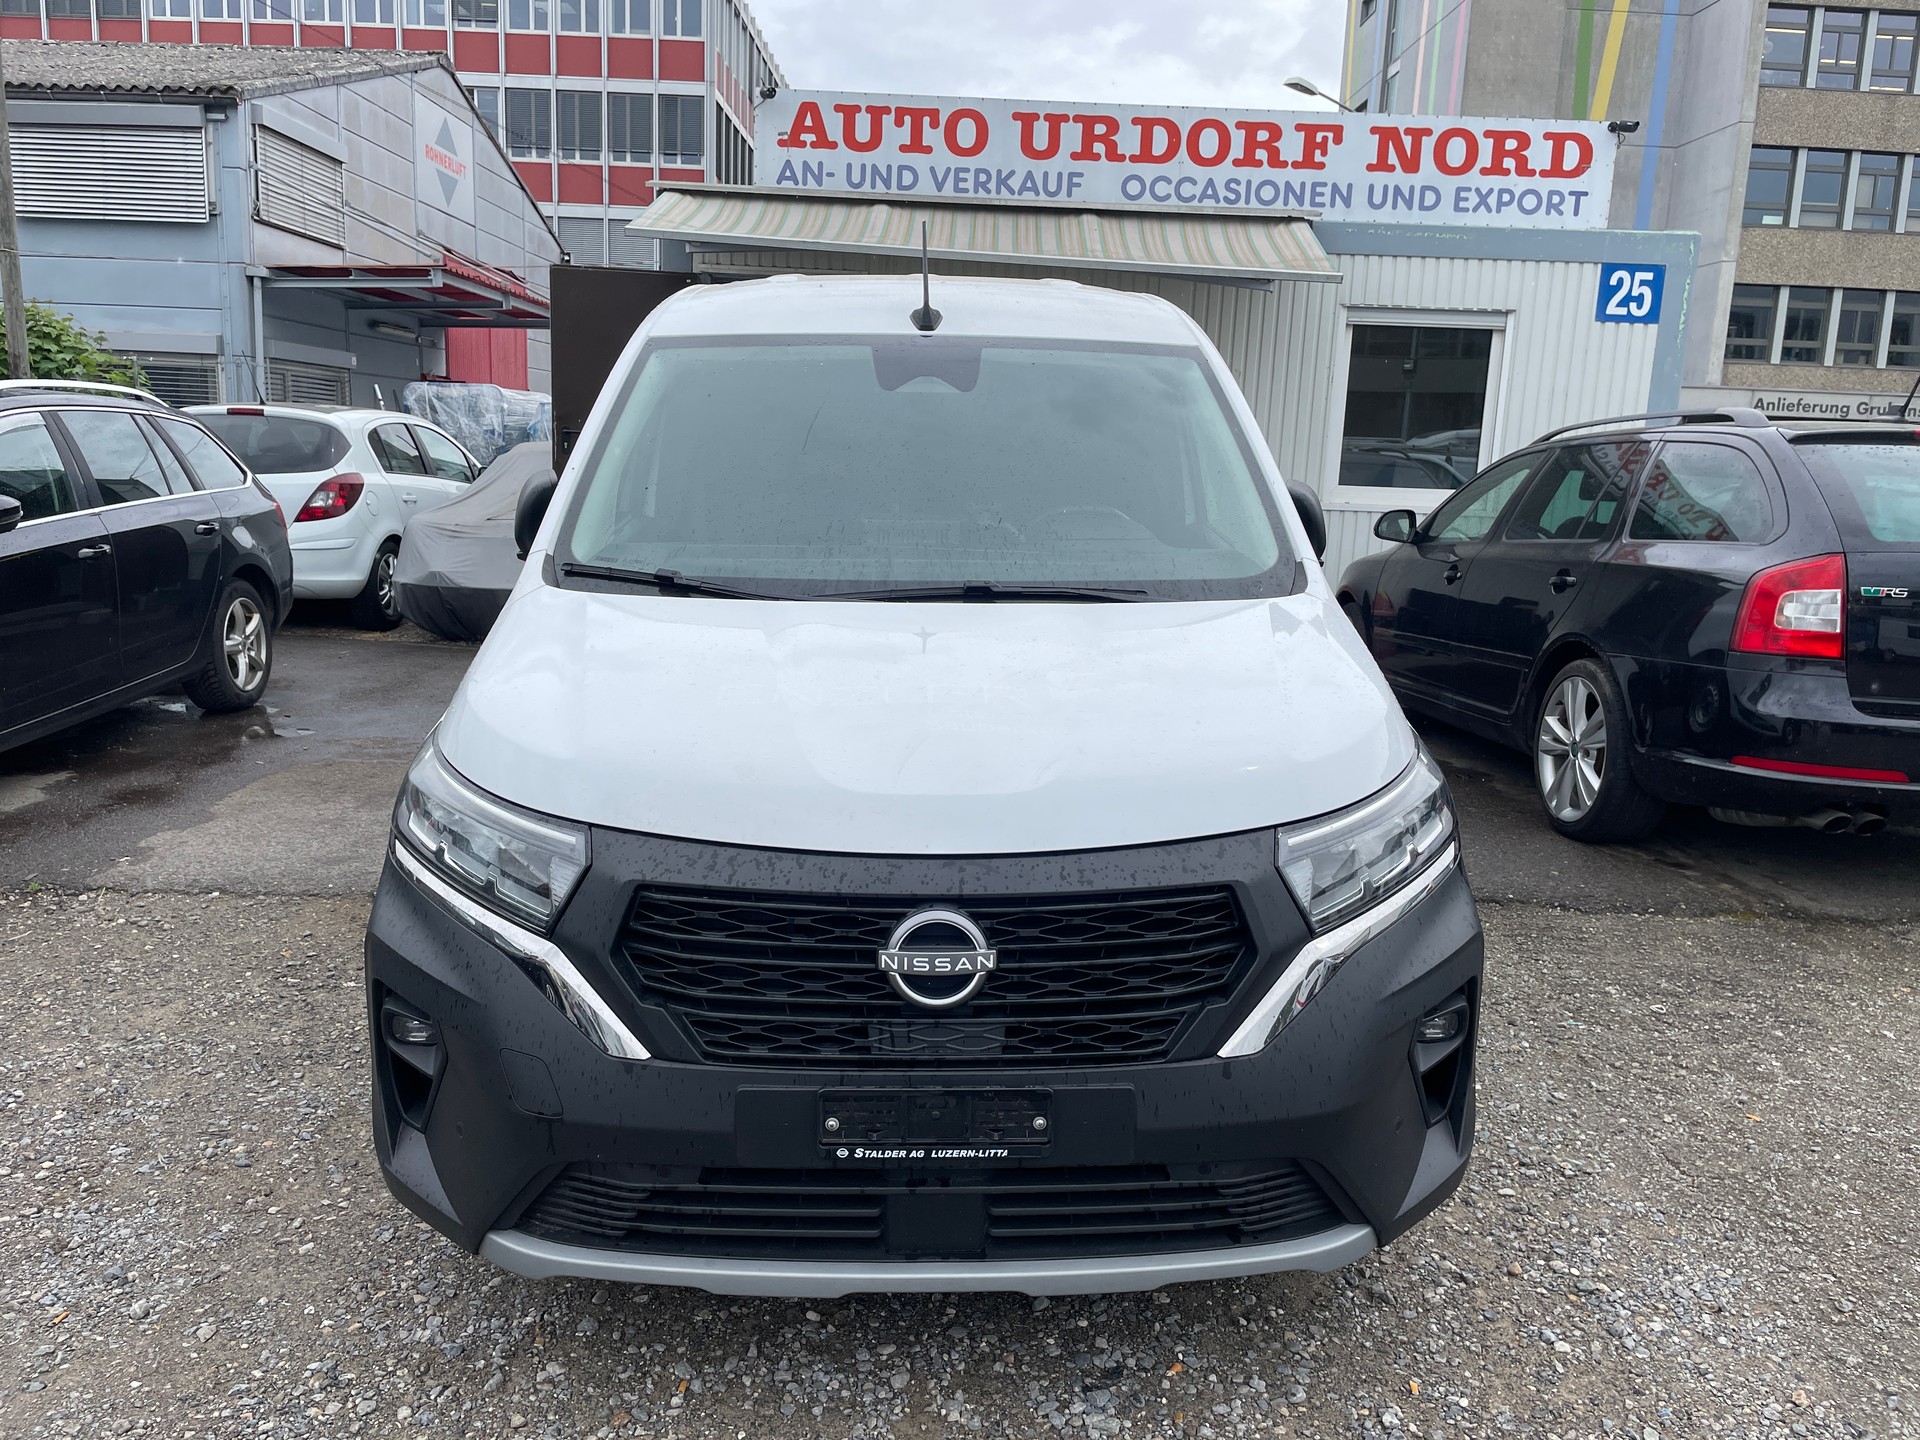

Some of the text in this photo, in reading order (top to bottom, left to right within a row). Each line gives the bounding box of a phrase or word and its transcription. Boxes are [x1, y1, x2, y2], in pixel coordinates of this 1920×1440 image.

[777, 101, 1593, 179] AUTO URDORF NORD
[425, 143, 467, 180] ROHNERLUFT
[775, 159, 1590, 218] AN- UND VERKAUF OCCASIONEN UND EXPORT
[1605, 270, 1654, 317] 25
[1753, 396, 1850, 418] Anlieferung
[881, 954, 994, 972] NISSAN
[853, 1147, 906, 1158] STALDER
[908, 1149, 925, 1158] AG
